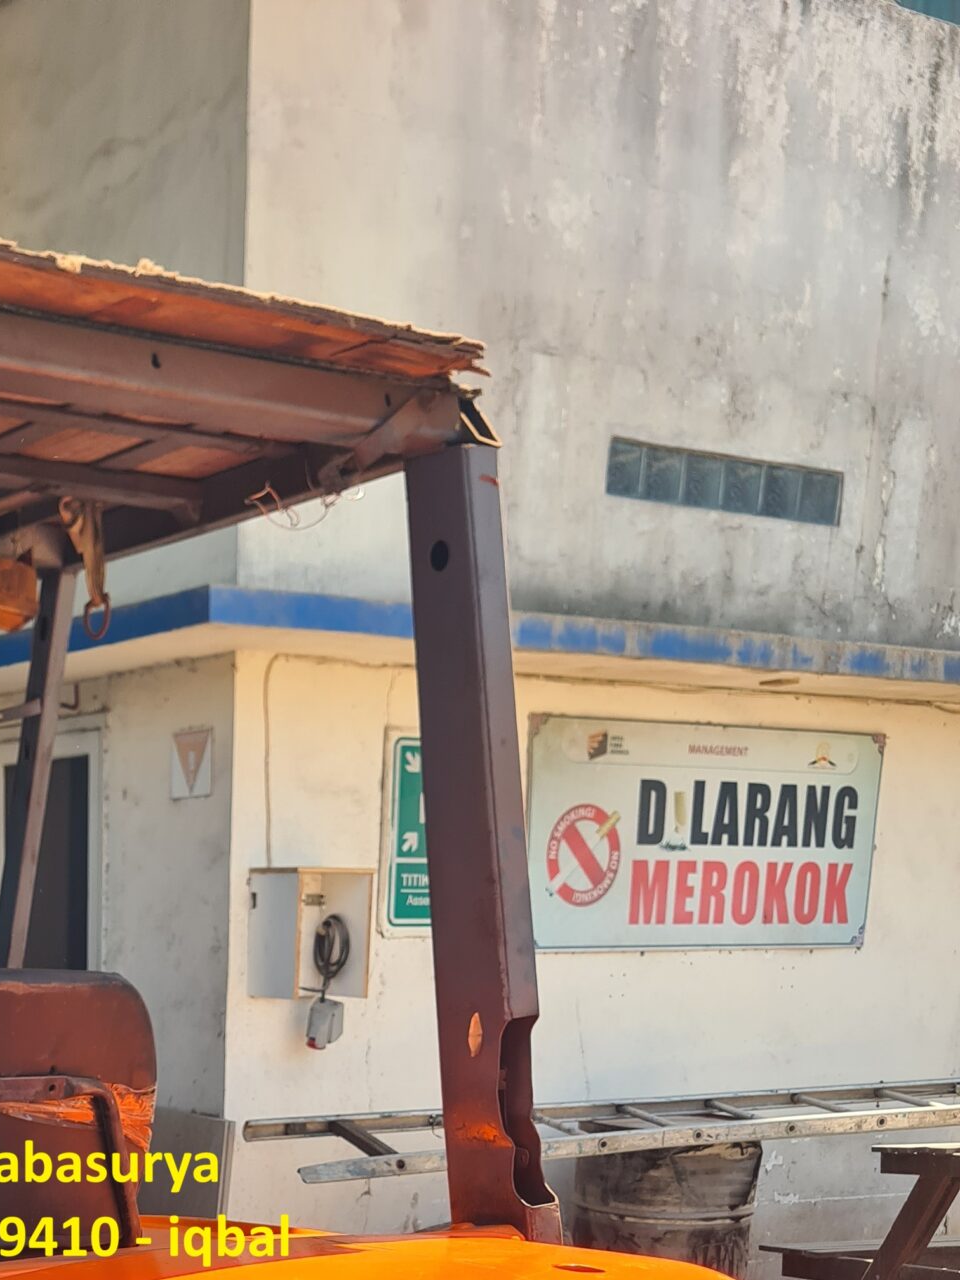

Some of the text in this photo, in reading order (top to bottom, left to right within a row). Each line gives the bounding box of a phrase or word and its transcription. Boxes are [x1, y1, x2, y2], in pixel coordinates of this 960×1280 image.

[688, 743, 749, 757] MANAGEMENT
[636, 778, 859, 850] DILARANG
[628, 859, 854, 926] MEROKOK
